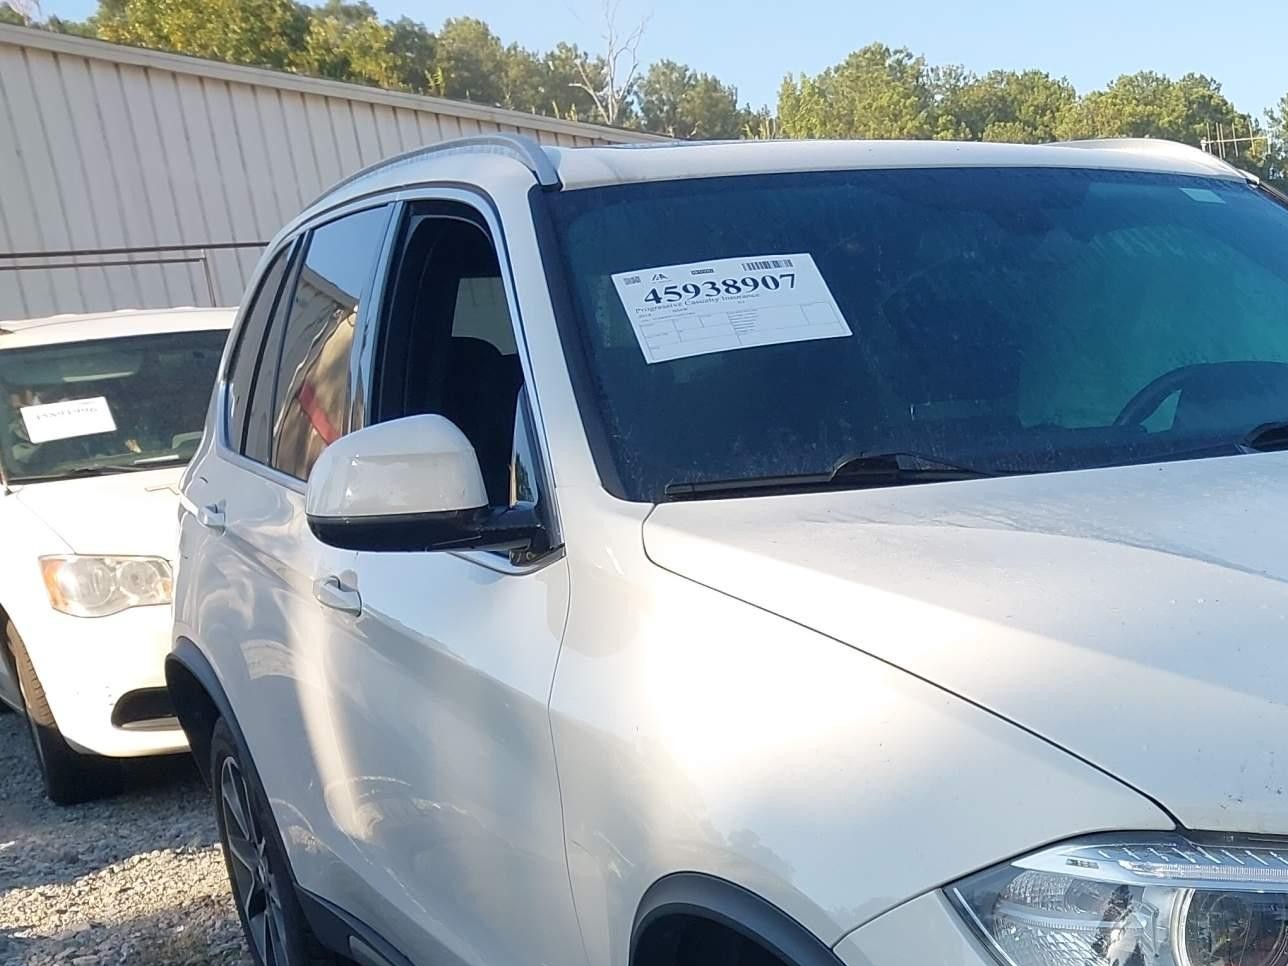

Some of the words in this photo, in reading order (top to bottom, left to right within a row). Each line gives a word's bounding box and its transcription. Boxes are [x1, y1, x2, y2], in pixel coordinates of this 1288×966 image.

[644, 273, 796, 304] 45938907
[635, 302, 682, 314] Progressive
[684, 296, 720, 306] Casualty
[721, 292, 760, 302] Insurance
